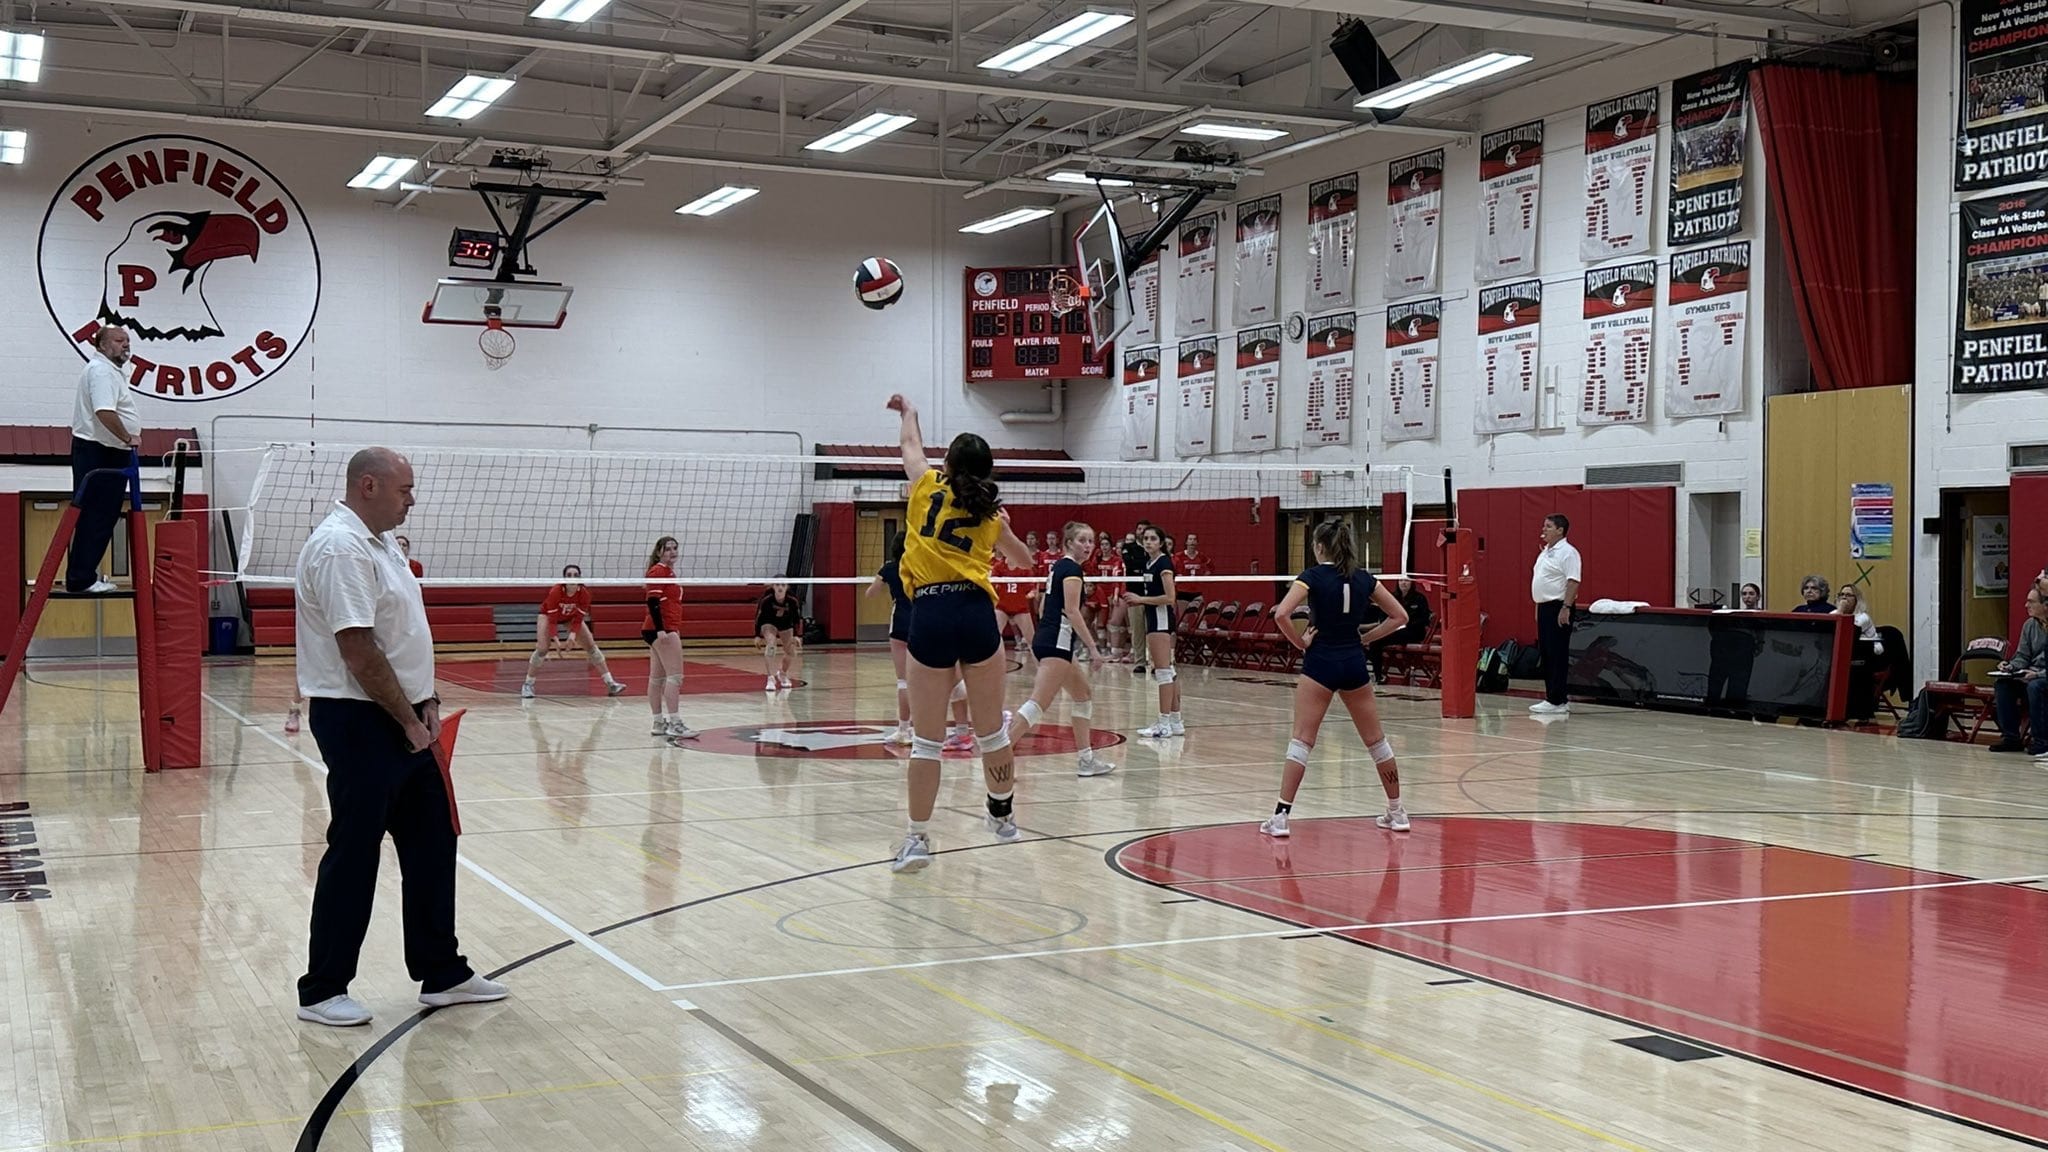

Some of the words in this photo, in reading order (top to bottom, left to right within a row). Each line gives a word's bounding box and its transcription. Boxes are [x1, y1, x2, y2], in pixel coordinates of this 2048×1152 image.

[1973, 25, 1997, 36] Class
[1999, 21, 2012, 30] AA
[2014, 10, 2048, 26] Volleyba
[1981, 11, 2000, 22] New
[2002, 5, 2022, 17] York
[2023, 0, 2047, 12] State
[1968, 24, 2048, 53] CHAMPION
[1589, 98, 1621, 130] PENFIELD
[1622, 89, 1657, 113] PATRIOTS
[1964, 124, 2048, 156] PENFIEL
[1962, 149, 2048, 182] PATRIOT
[71, 148, 289, 235] PENFIELD
[1675, 186, 1742, 216] PENFIELD
[1673, 209, 1740, 238] PATRIOTS
[1971, 229, 1996, 240] Class
[1997, 226, 2010, 236] AA
[2011, 220, 2048, 234] Volleyba
[1980, 217, 1998, 227] New
[2000, 212, 2020, 223] York
[2021, 209, 2045, 220] State
[456, 241, 492, 258] 30
[1967, 233, 2048, 256] CHAMPION
[1673, 250, 1709, 280] PENFIELD
[1709, 243, 1749, 268] PATRIOTS
[117, 264, 157, 307] P
[1587, 267, 1620, 296] PENFIELD
[1620, 261, 1655, 286] PATRIOTS
[973, 298, 1018, 311] PENFIELD
[1025, 303, 1049, 312] PERIOD
[971, 339, 993, 348] FOULS
[1014, 337, 1040, 346] PLAYER
[1043, 336, 1061, 345] FOUL
[1962, 334, 2047, 359] PENFIEL
[72, 319, 288, 396] PTRIOTS
[971, 369, 993, 378] SCORE
[1025, 368, 1049, 376] MATCH
[1081, 366, 1104, 375] SCORE
[1961, 359, 2048, 384] PATRIOT
[920, 489, 982, 552] 12
[1007, 583, 1018, 593] 12
[1343, 583, 1350, 614] 1
